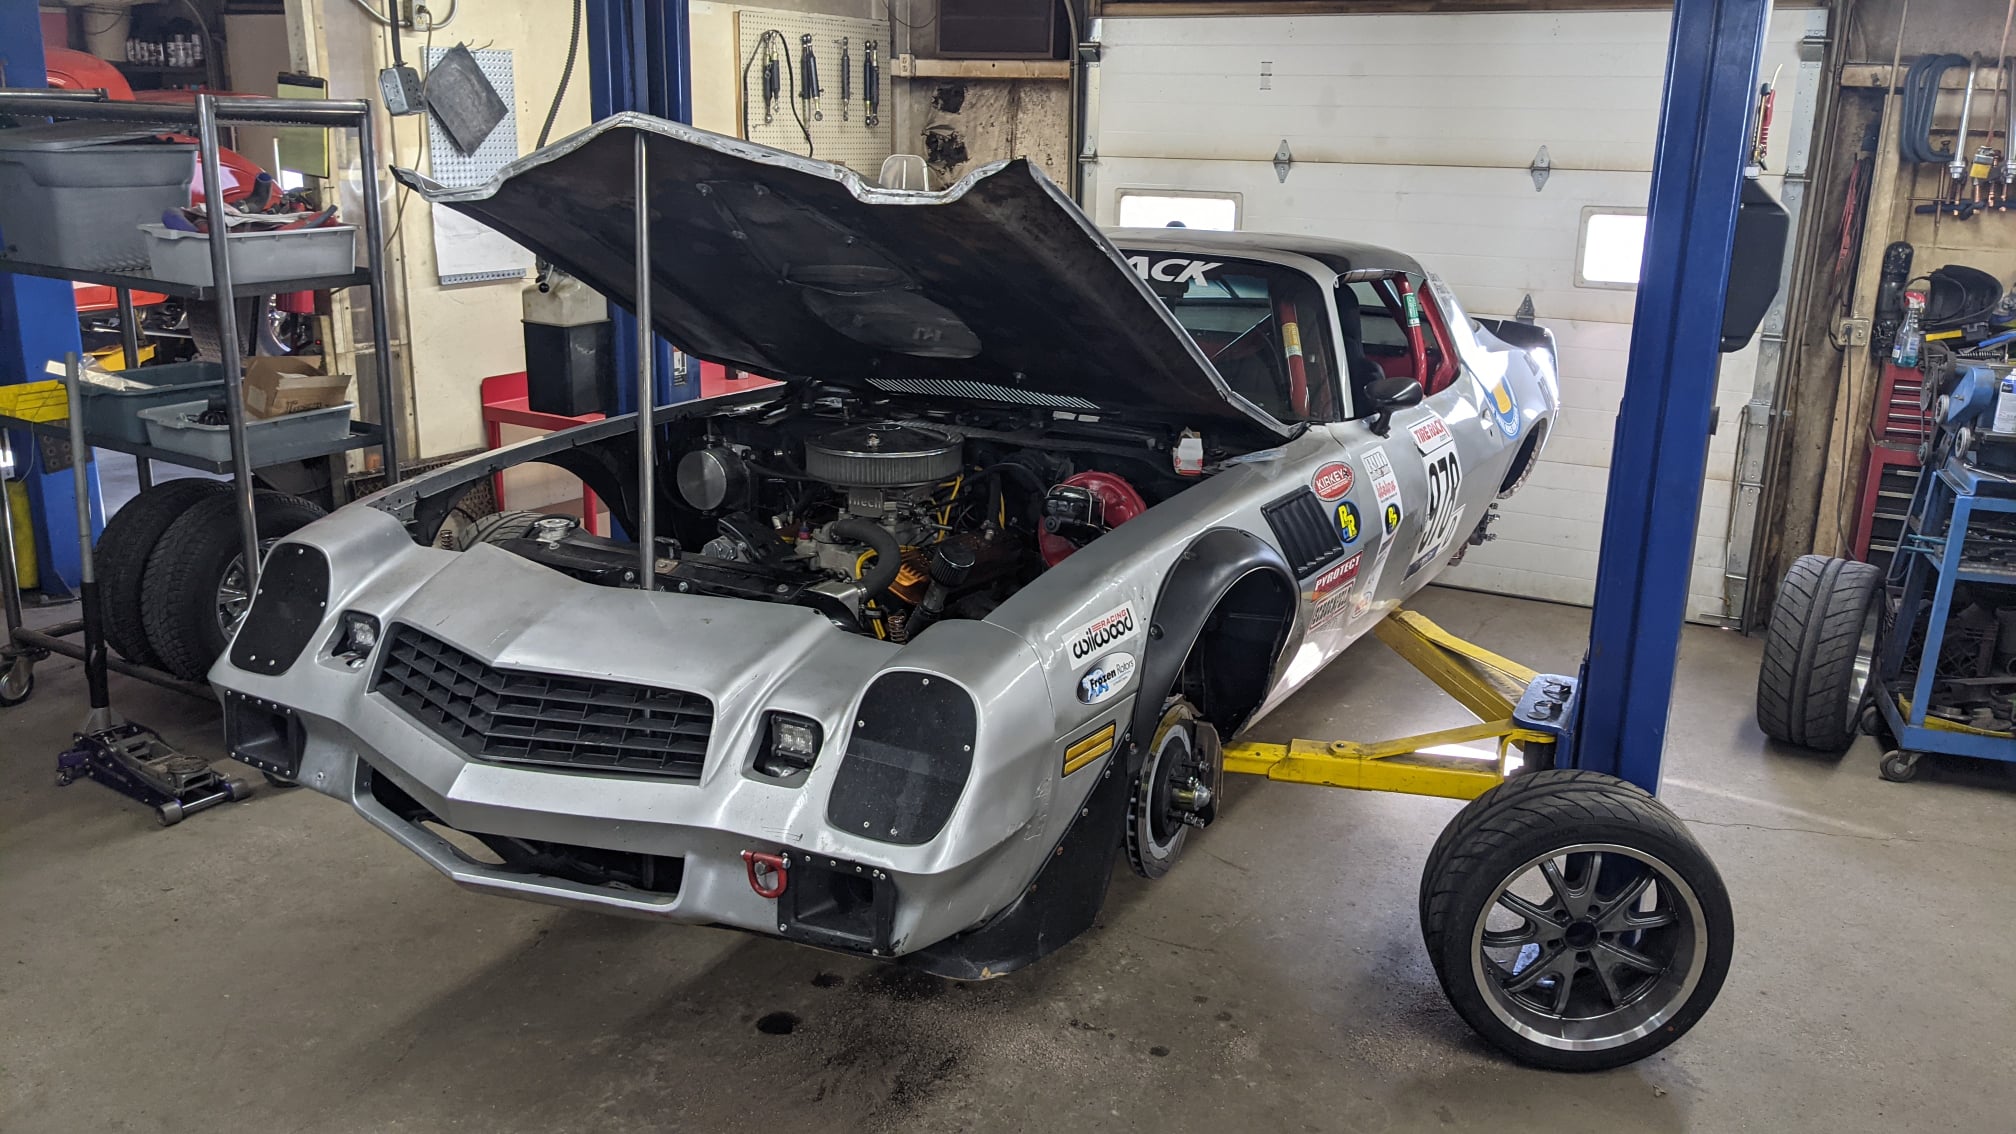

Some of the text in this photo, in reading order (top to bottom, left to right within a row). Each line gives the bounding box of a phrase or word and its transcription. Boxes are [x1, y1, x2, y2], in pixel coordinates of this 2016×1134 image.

[1413, 425, 1432, 444] TIRE
[1316, 468, 1345, 491] KIRKEY
[1314, 555, 1361, 592] PYROTECT
[1100, 609, 1127, 628] RACING
[1072, 607, 1134, 659] wilwood
[1089, 668, 1117, 690] Frozen
[1115, 659, 1134, 676] Rotors
